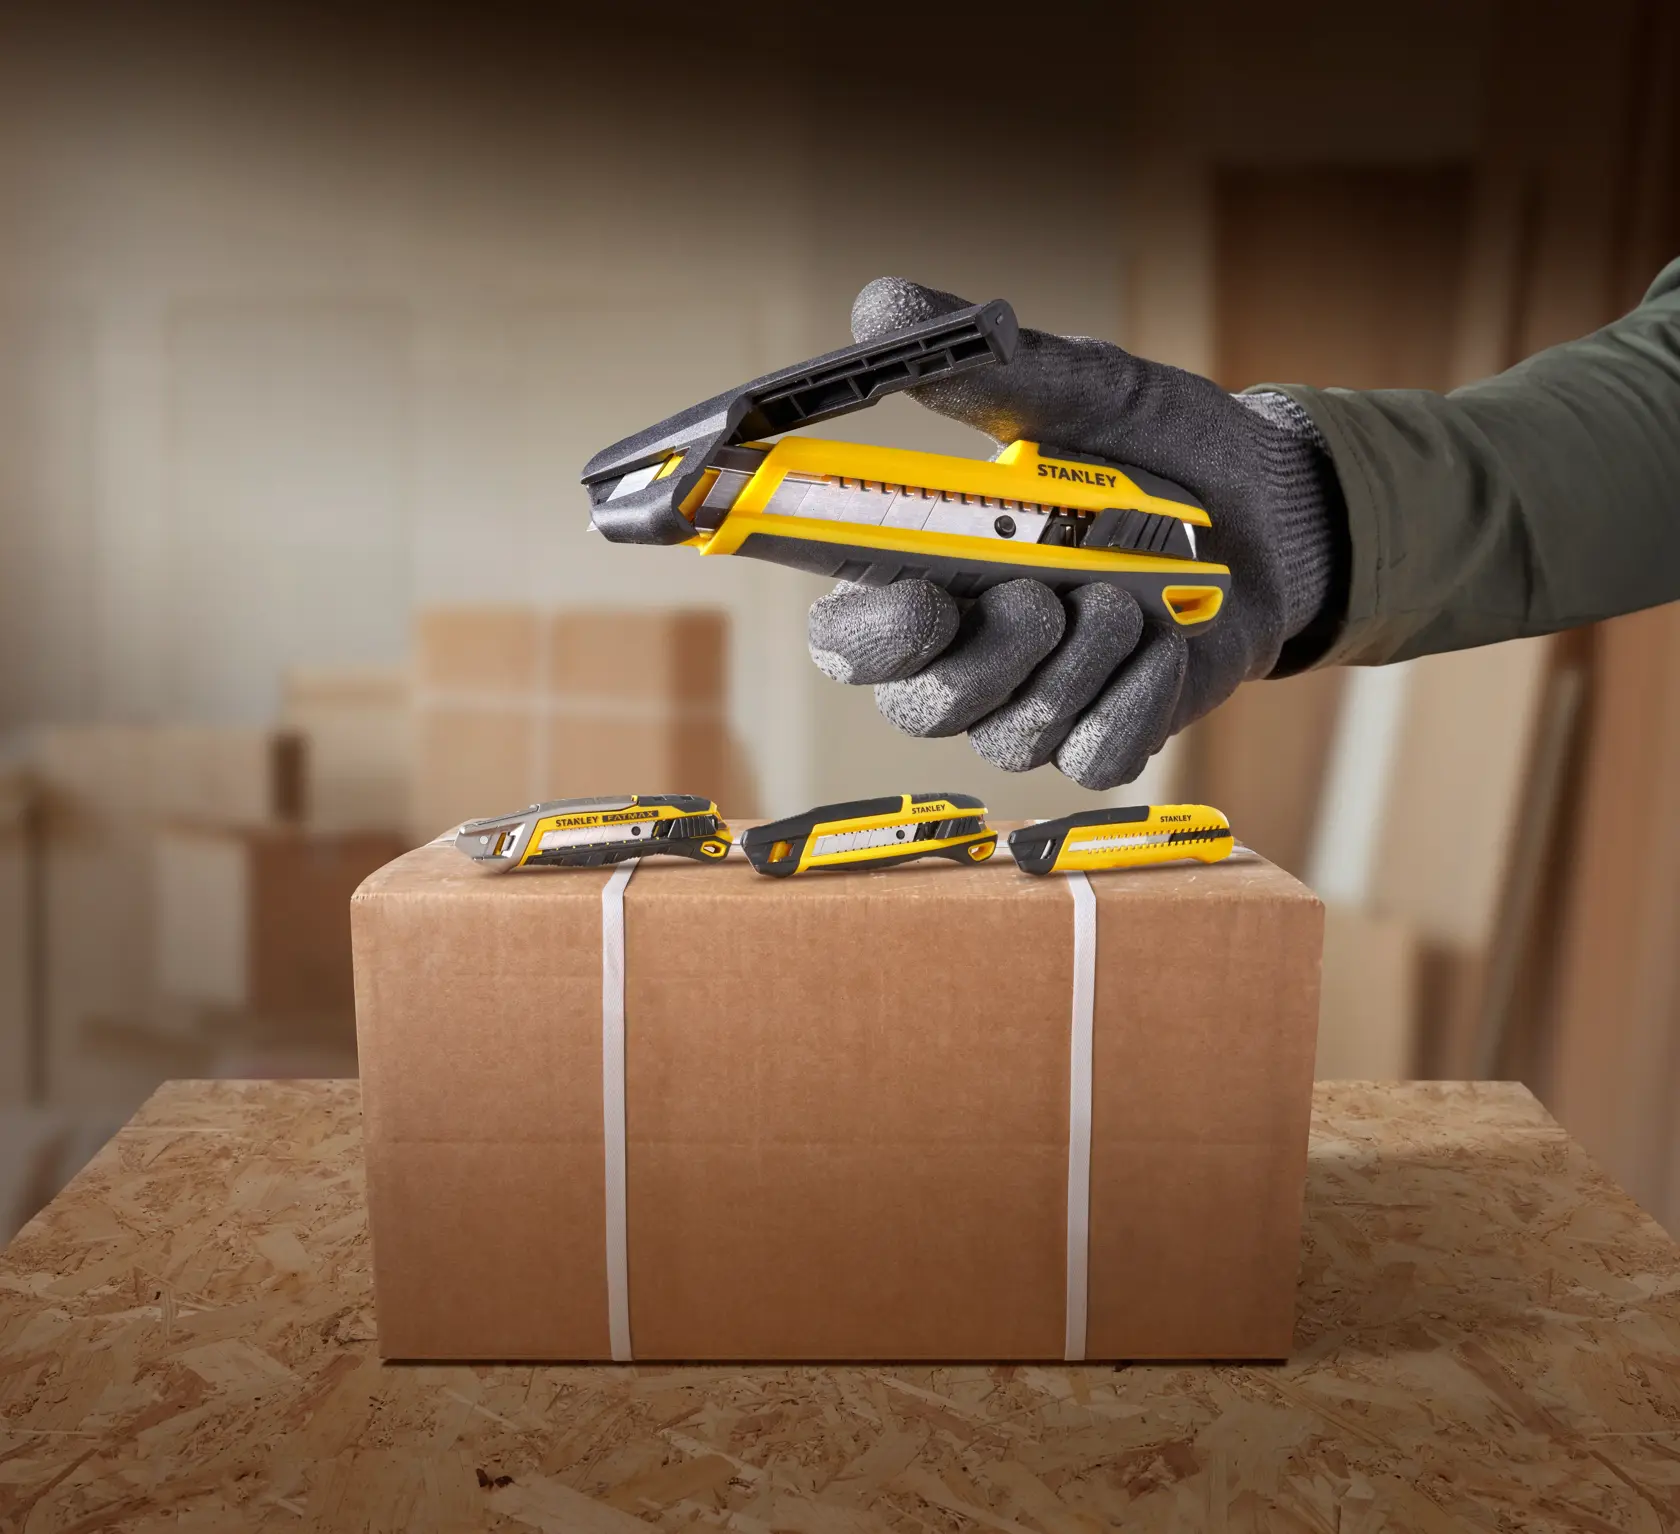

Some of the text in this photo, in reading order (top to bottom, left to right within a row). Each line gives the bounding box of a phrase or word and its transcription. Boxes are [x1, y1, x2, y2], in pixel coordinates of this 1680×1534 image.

[1037, 464, 1117, 488] STANLEY
[911, 804, 946, 815] STANLEY
[555, 811, 654, 827] STANLEY FATMAX
[1160, 814, 1192, 823] STANLEY
